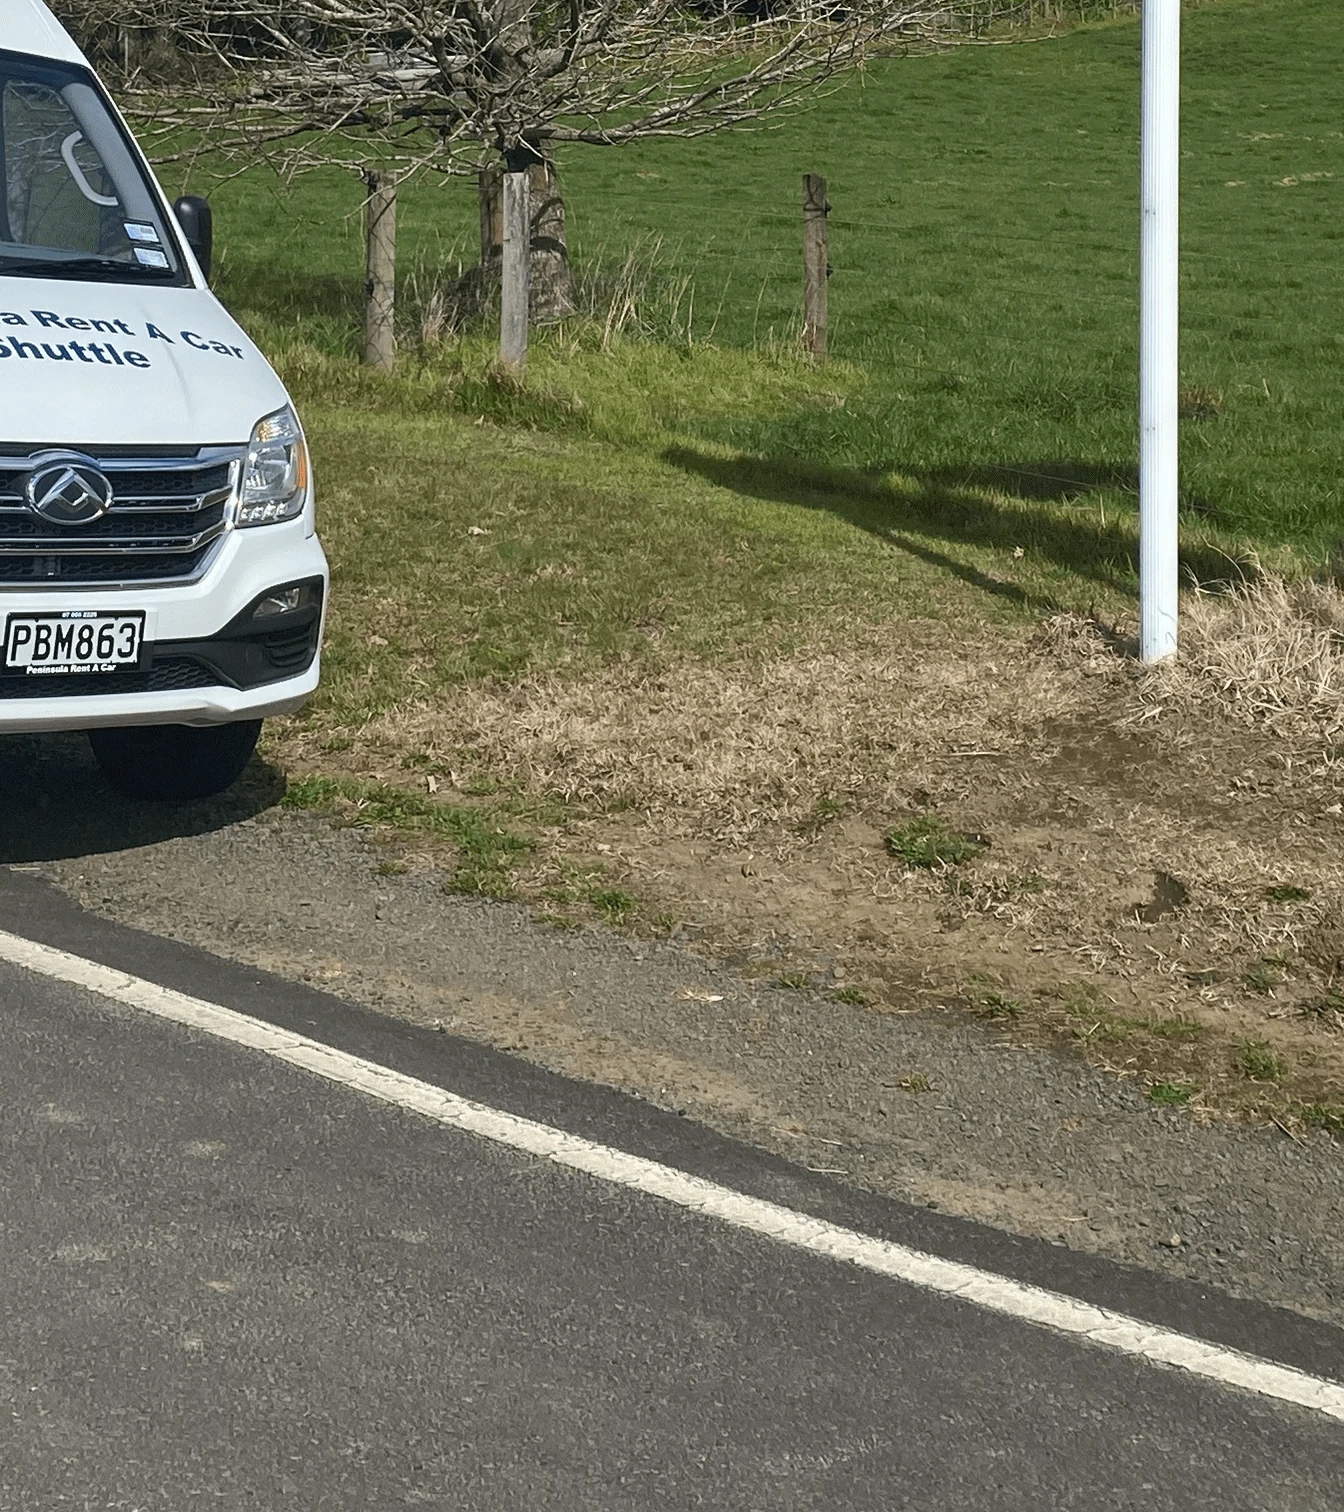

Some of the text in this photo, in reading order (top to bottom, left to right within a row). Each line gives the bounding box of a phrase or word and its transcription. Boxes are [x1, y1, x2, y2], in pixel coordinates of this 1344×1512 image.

[30, 310, 136, 336] Rent
[145, 322, 176, 344] A
[180, 331, 245, 359] Car
[10, 622, 137, 662] PBM863
[25, 663, 117, 675] Peninsula Rent A Car
